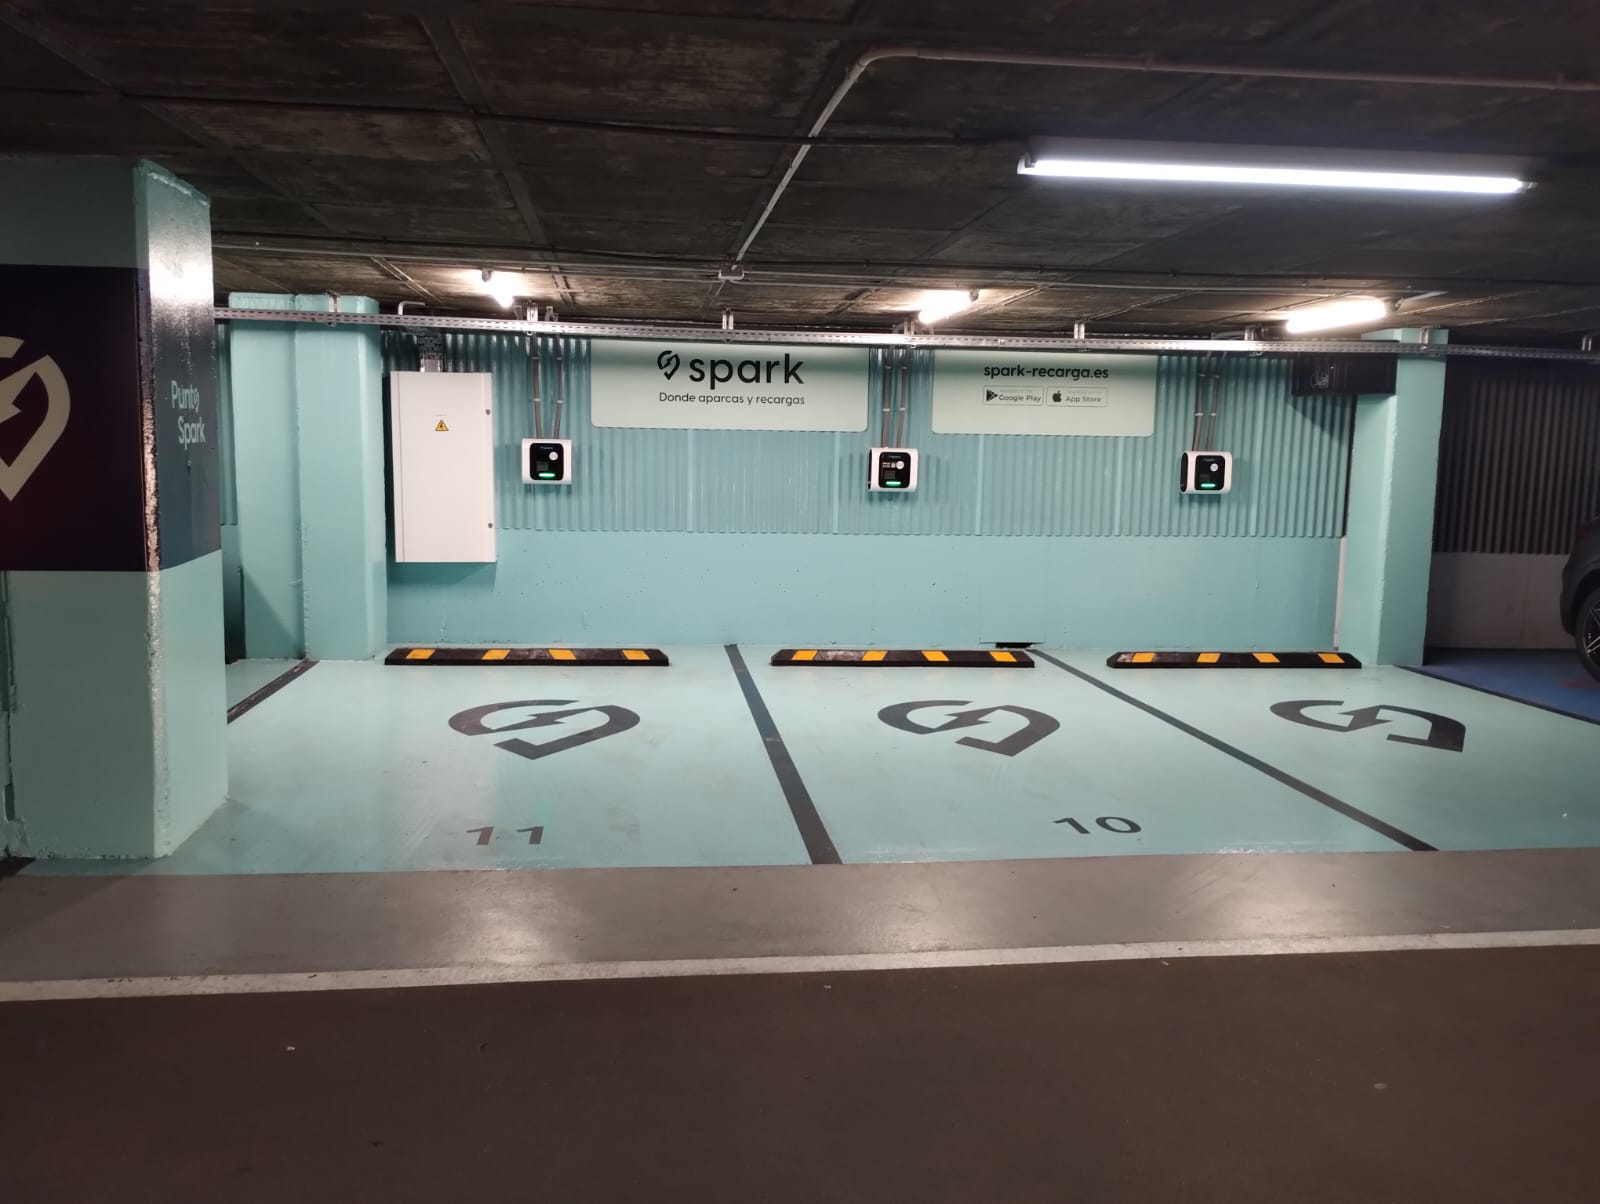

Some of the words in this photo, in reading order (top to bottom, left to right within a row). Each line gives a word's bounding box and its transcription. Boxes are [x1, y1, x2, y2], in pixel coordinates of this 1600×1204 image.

[689, 353, 804, 390] spark
[984, 365, 1109, 381] spark-recarga.es
[659, 392, 696, 402] Donde
[698, 394, 744, 404] aparcas
[747, 396, 753, 405] y
[756, 396, 805, 406] recargas
[999, 394, 1024, 402] Google
[1026, 394, 1041, 402] Play
[1065, 395, 1080, 403] App
[1082, 395, 1102, 403] Store
[178, 415, 206, 451] Spark
[1052, 816, 1142, 834] 10
[466, 826, 544, 846] 11
